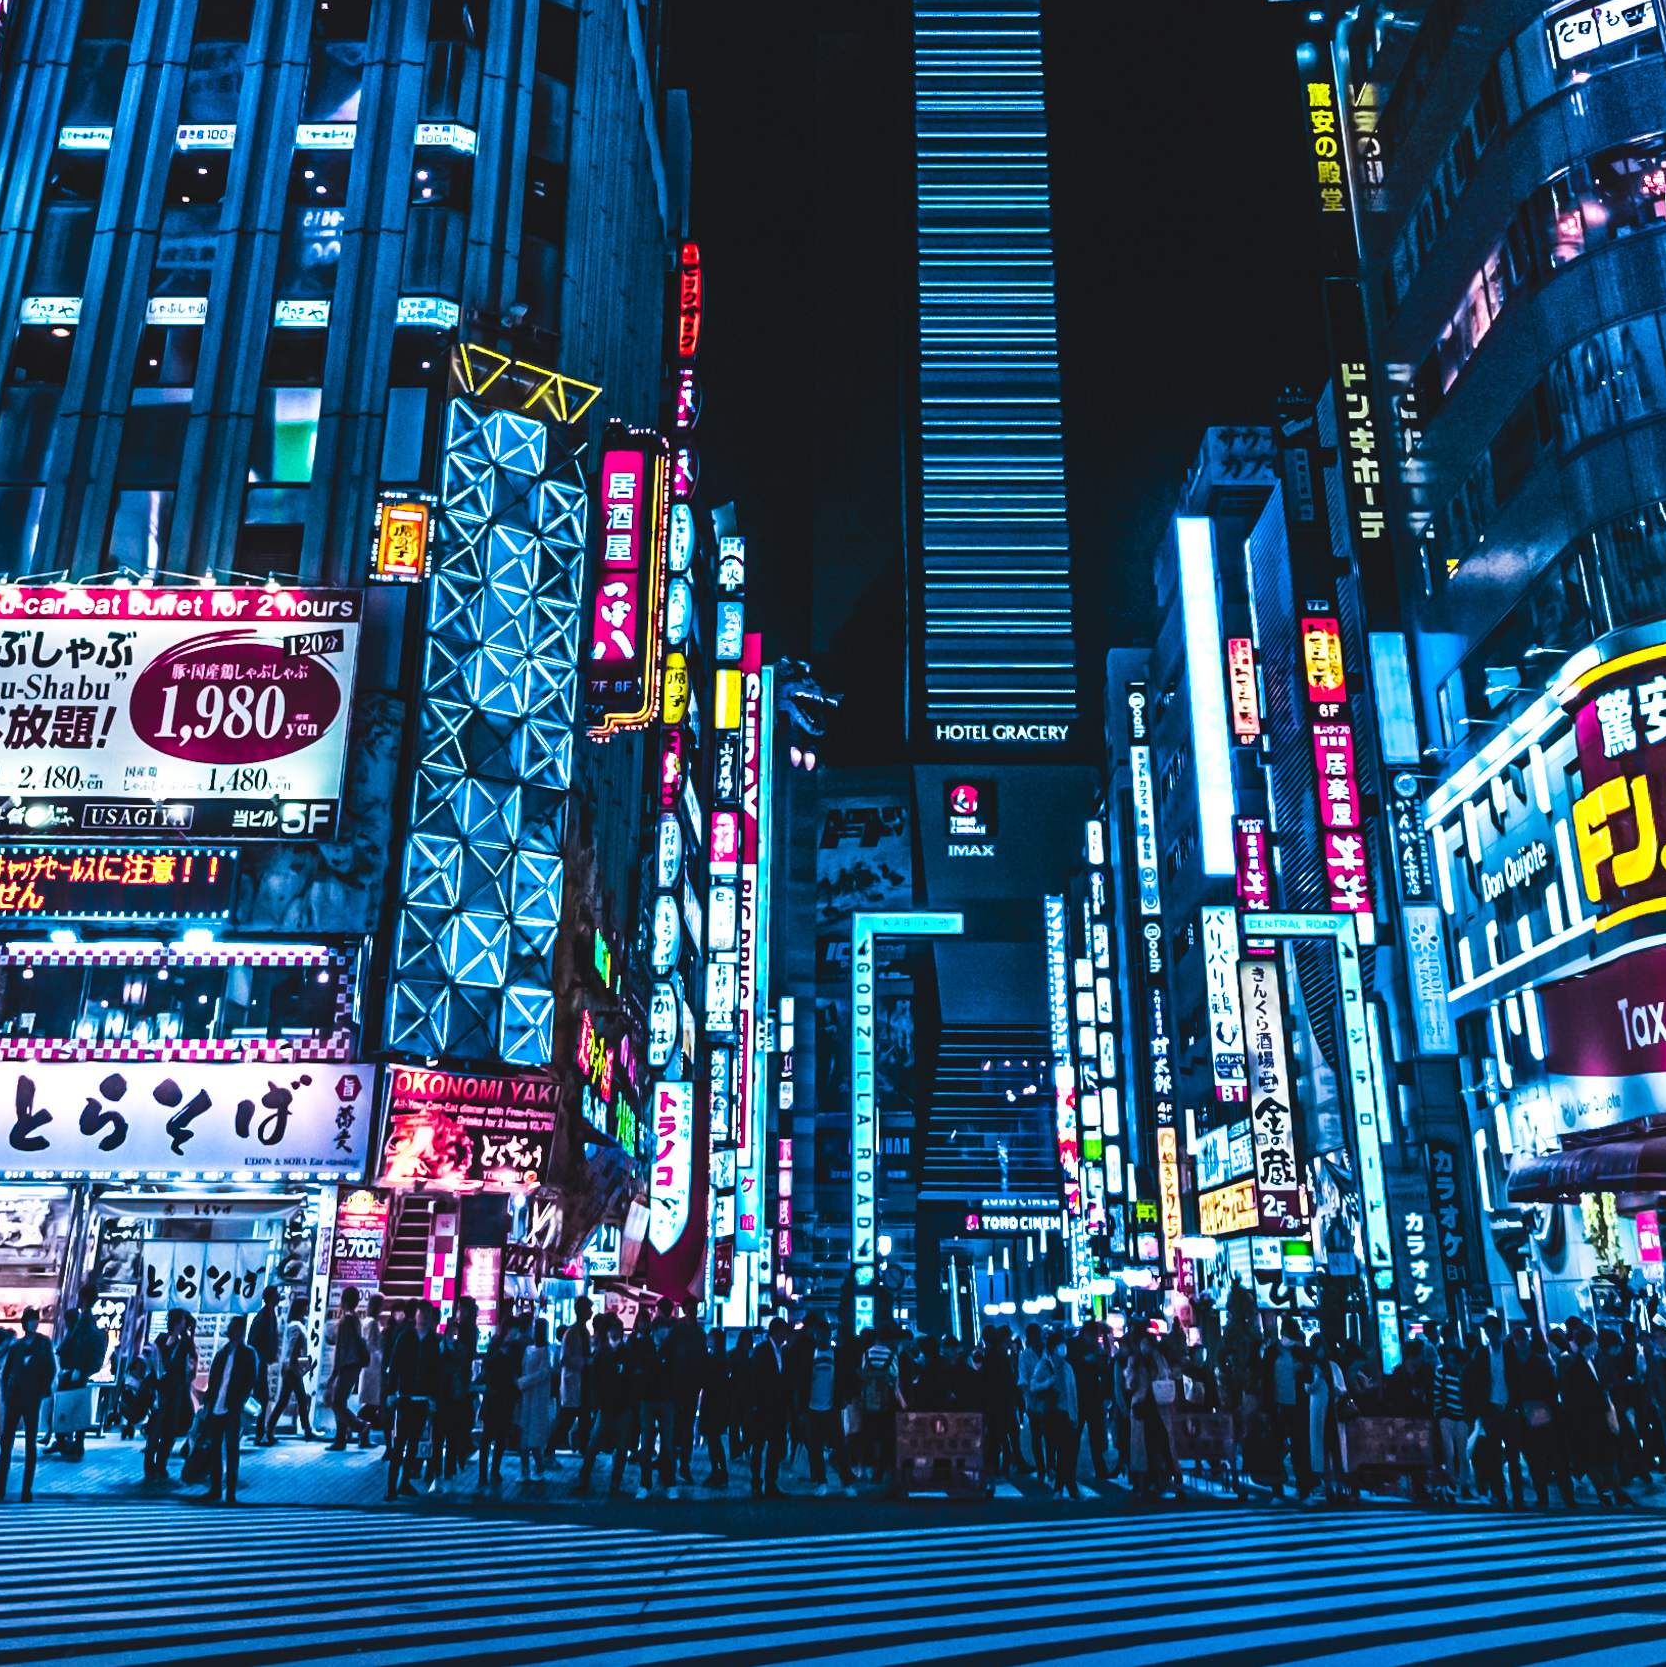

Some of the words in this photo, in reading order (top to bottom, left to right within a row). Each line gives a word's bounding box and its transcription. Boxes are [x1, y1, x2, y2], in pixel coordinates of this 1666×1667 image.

[1307, 82, 1346, 213] 驚安の殿堂
[606, 473, 637, 562] 居酒屋
[255, 594, 273, 616] 2
[592, 581, 635, 661] つぼ八
[286, 635, 339, 656] 120分
[153, 684, 286, 746] 1,980
[285, 719, 319, 740] yen
[935, 724, 991, 741] HOTEL
[992, 724, 1070, 741] GRACERY
[1318, 704, 1339, 718] 6F
[17, 764, 79, 792] 2,480
[77, 777, 104, 792] yen
[206, 767, 268, 793] 1,480
[1324, 752, 1354, 826] 居楽屋
[90, 806, 187, 826] USAGIYA
[231, 809, 279, 829] 当ビル
[281, 803, 331, 834] 5F
[947, 844, 996, 857] IMAX
[1480, 856, 1505, 905] Don
[1503, 840, 1548, 892] Quijote
[1249, 965, 1275, 1069] きんくら酒場
[396, 1072, 503, 1102] OKONOMI
[510, 1080, 561, 1105] YAKI
[1150, 1035, 1173, 1095] 甘太郎
[8, 1073, 313, 1158] とらそば
[1220, 1084, 1247, 1102] B1
[655, 1090, 677, 1187] トラノコ
[1254, 1096, 1296, 1187] 金の蔵
[1262, 1194, 1287, 1218] 2F
[1434, 1149, 1465, 1259] カラオケ
[145, 1264, 267, 1299] とらそば
[1405, 1213, 1433, 1305] カラオケ
